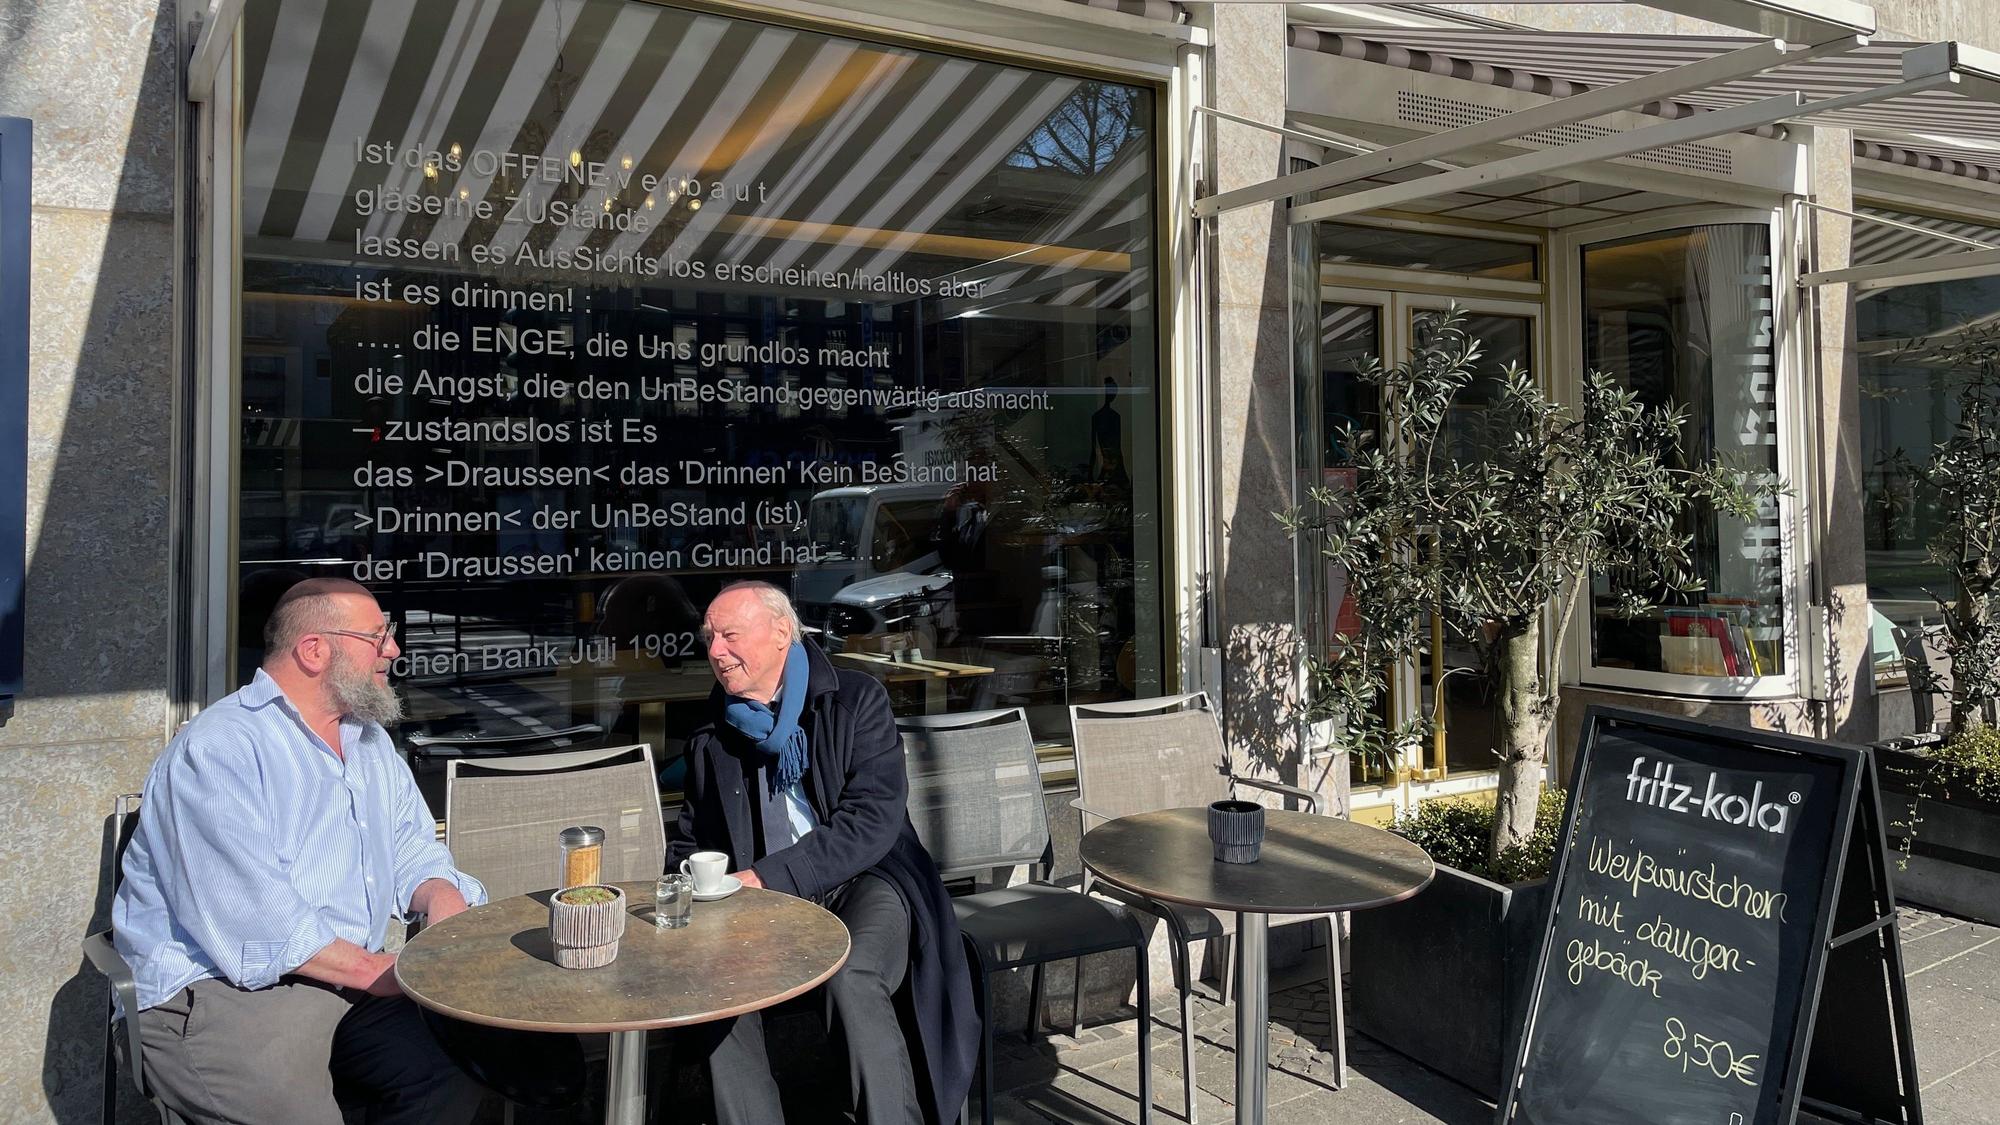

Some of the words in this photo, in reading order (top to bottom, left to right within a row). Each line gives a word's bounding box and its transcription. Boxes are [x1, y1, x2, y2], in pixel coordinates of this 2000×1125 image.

[355, 136, 394, 165] Ist
[405, 143, 462, 172] das
[473, 149, 606, 187] OFFENE
[355, 184, 493, 219] gläserne
[504, 196, 649, 233] ZUStände
[355, 229, 459, 262] lassen
[471, 244, 506, 265] es
[515, 241, 658, 275] AusSichts
[668, 250, 704, 279] los
[939, 275, 987, 300] aber
[355, 275, 392, 303] ist
[403, 282, 440, 306] es
[451, 283, 573, 313] drinnen!
[413, 324, 460, 352] die
[471, 327, 575, 360] ENGE,
[586, 331, 628, 358] die
[638, 335, 691, 360] Uns
[700, 340, 809, 368] grundlos
[818, 345, 890, 369] macht
[354, 369, 403, 395] die
[412, 369, 513, 403] Angst,
[524, 373, 567, 399] die
[577, 375, 630, 401] den
[640, 377, 790, 405] UnBeStand
[798, 384, 940, 413] gegenwärtig
[947, 388, 1055, 411] ausmacht.
[385, 418, 570, 443] zustandslos
[581, 418, 612, 443] ist
[623, 418, 658, 443] Es
[353, 461, 412, 487] das
[426, 461, 610, 487] >Draussen<
[620, 461, 669, 486] das
[679, 460, 792, 485] 'Drinnen'
[800, 460, 852, 484] Kein
[862, 460, 957, 484] BeStand
[964, 460, 998, 483] hat
[353, 506, 522, 533] >Drinnen<
[532, 506, 580, 531] der
[590, 501, 745, 529] UnBeStand
[353, 555, 407, 582] der
[418, 548, 579, 580] 'Draussen'
[590, 547, 681, 573] keinen
[691, 542, 771, 568] Grund
[781, 541, 818, 564] hat
[481, 640, 559, 674] Bank
[568, 636, 616, 666] Juli
[629, 632, 696, 661] 1982
[1578, 895, 1626, 934] mit
[1663, 1017, 1760, 1087] 8,50€
